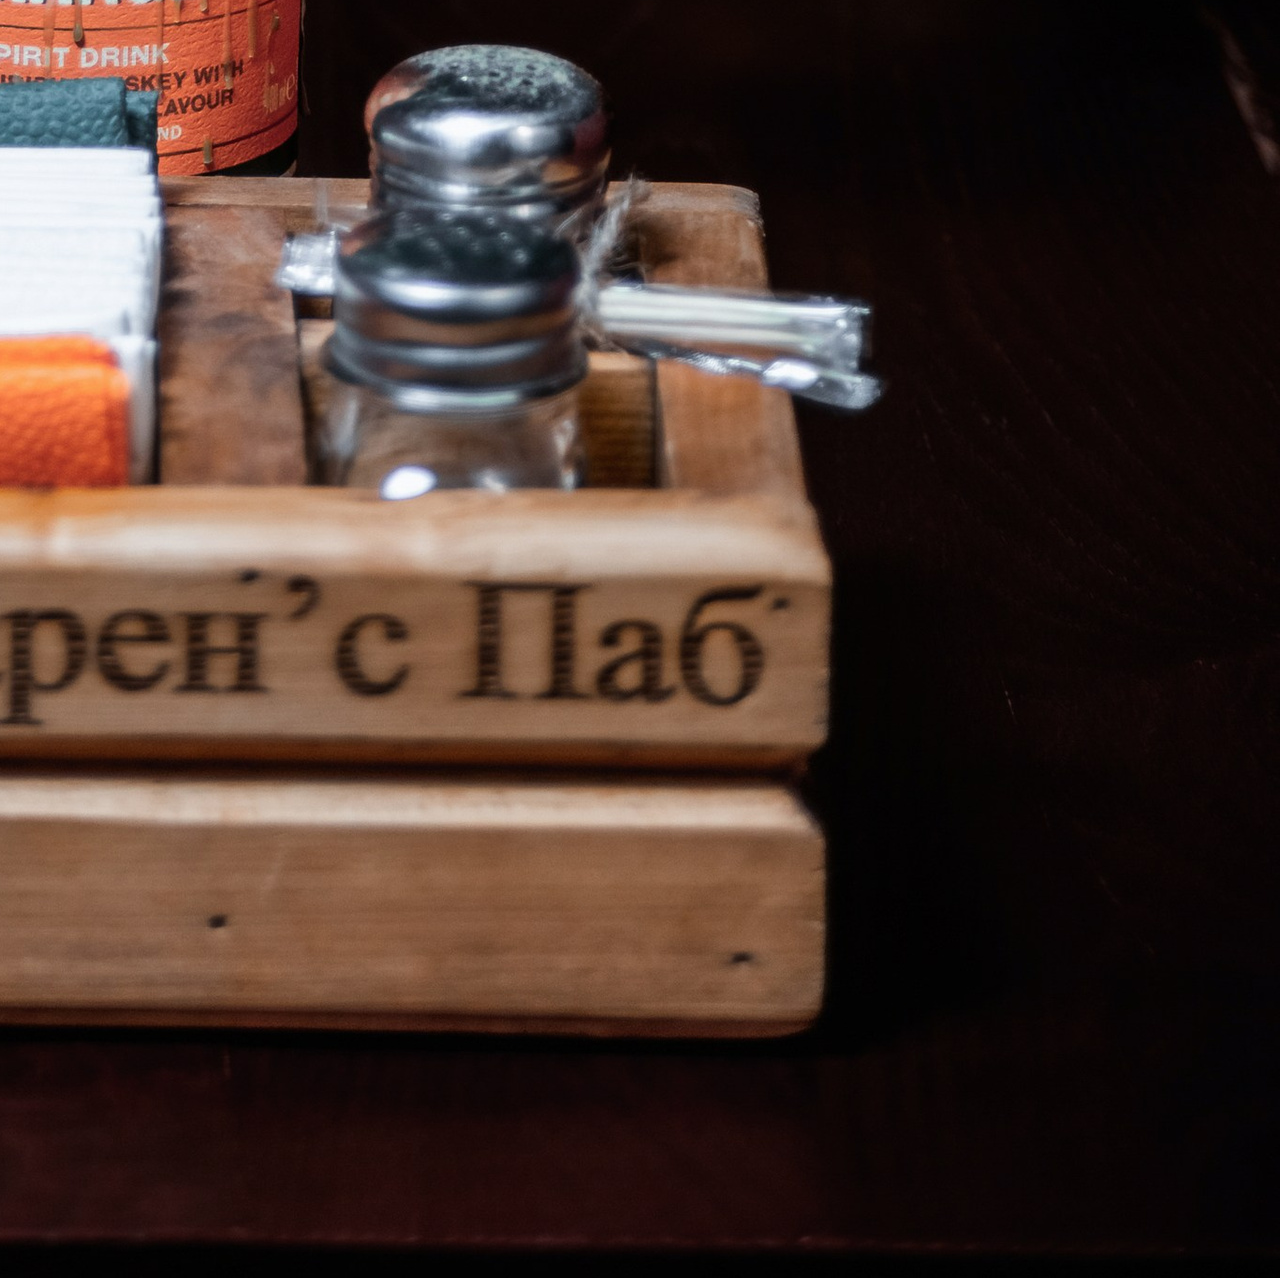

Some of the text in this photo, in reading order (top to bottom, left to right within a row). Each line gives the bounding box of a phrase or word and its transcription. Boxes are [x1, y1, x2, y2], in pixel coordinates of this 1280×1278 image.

[80, 42, 171, 68] DRINK
[193, 59, 244, 87] WITH
[455, 577, 766, 708] Паб
